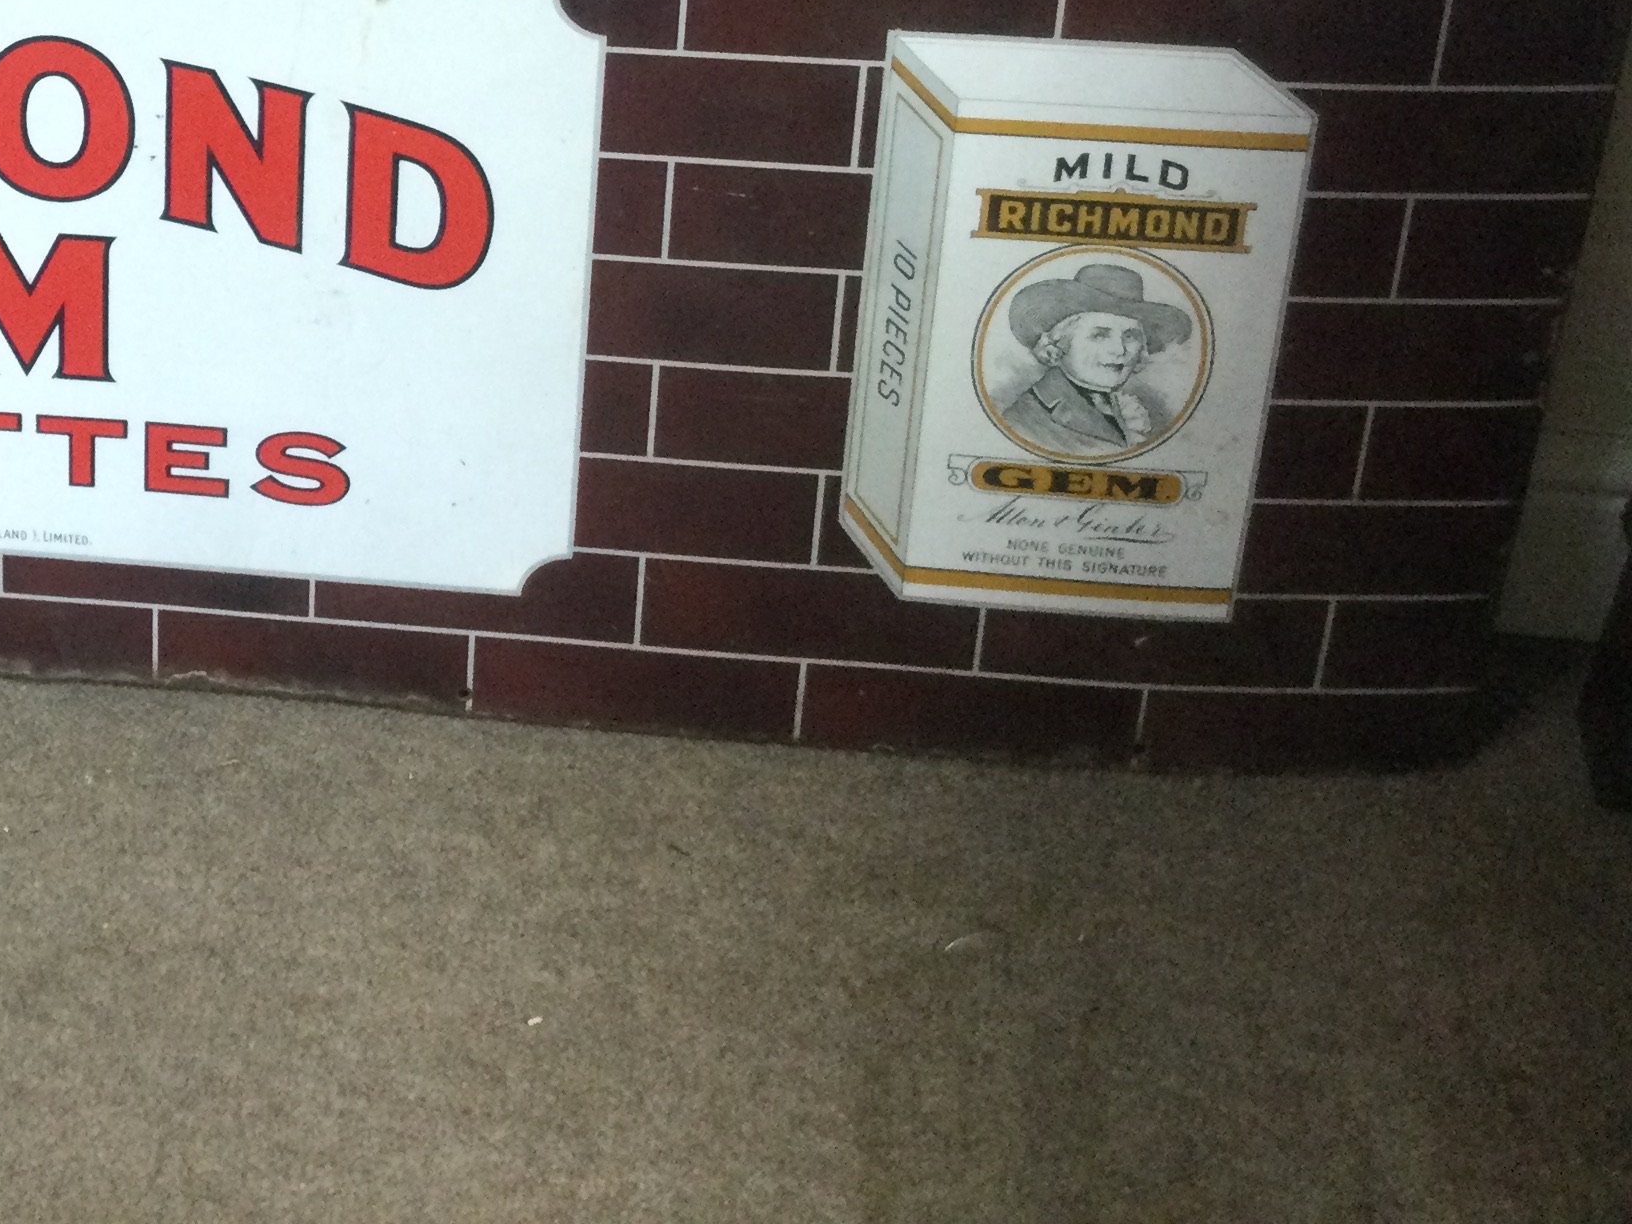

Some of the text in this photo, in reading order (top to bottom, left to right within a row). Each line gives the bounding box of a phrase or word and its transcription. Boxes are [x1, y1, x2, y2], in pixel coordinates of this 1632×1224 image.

[1053, 152, 1190, 190] MILD
[998, 196, 1232, 244] RICHMOND
[877, 239, 917, 407] 10 PIECES
[962, 551, 1169, 577] WITHOUT THIS SIGNATURE
[1007, 539, 1126, 560] NONE GENUINE
